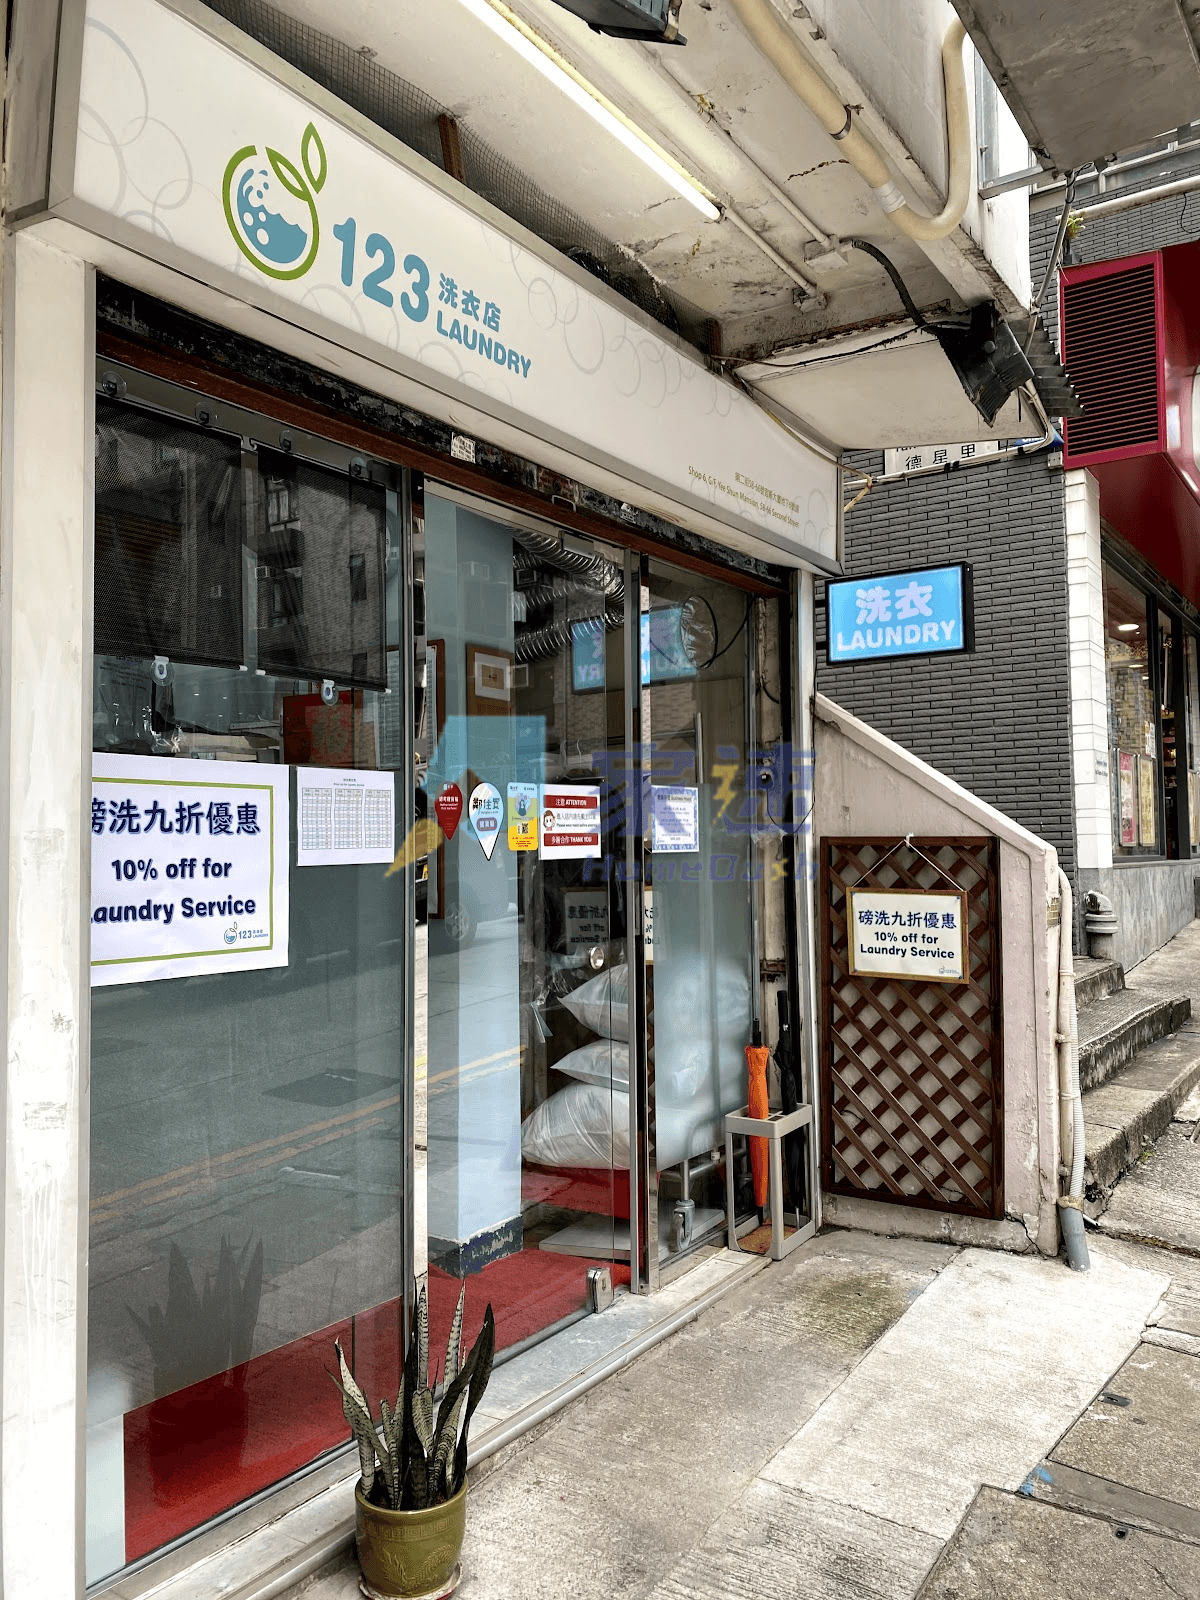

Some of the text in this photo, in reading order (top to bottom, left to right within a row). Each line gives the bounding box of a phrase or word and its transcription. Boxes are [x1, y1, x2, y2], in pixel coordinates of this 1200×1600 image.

[333, 217, 430, 322] 123
[439, 272, 501, 332] 洗衣店
[437, 310, 531, 378] LAUNDRY
[905, 443, 976, 468] 德星里
[688, 465, 702, 481] Shop
[702, 473, 708, 483] 6,
[717, 480, 726, 493] Yee
[726, 485, 739, 499] Shun
[740, 491, 759, 510] Mansion,
[760, 503, 772, 515] 58-66
[772, 508, 787, 522] Second
[787, 517, 799, 528] Street
[855, 581, 933, 625] 洗衣
[837, 619, 956, 652] LAUNDRY
[555, 798, 566, 807] 注意
[112, 857, 232, 881] 10% off for
[91, 895, 256, 924] aundry Service
[858, 909, 957, 930] 磅洗九折優惠
[238, 929, 252, 940] 123
[874, 931, 938, 944] 10% off for
[860, 943, 955, 959] Laundry Service
